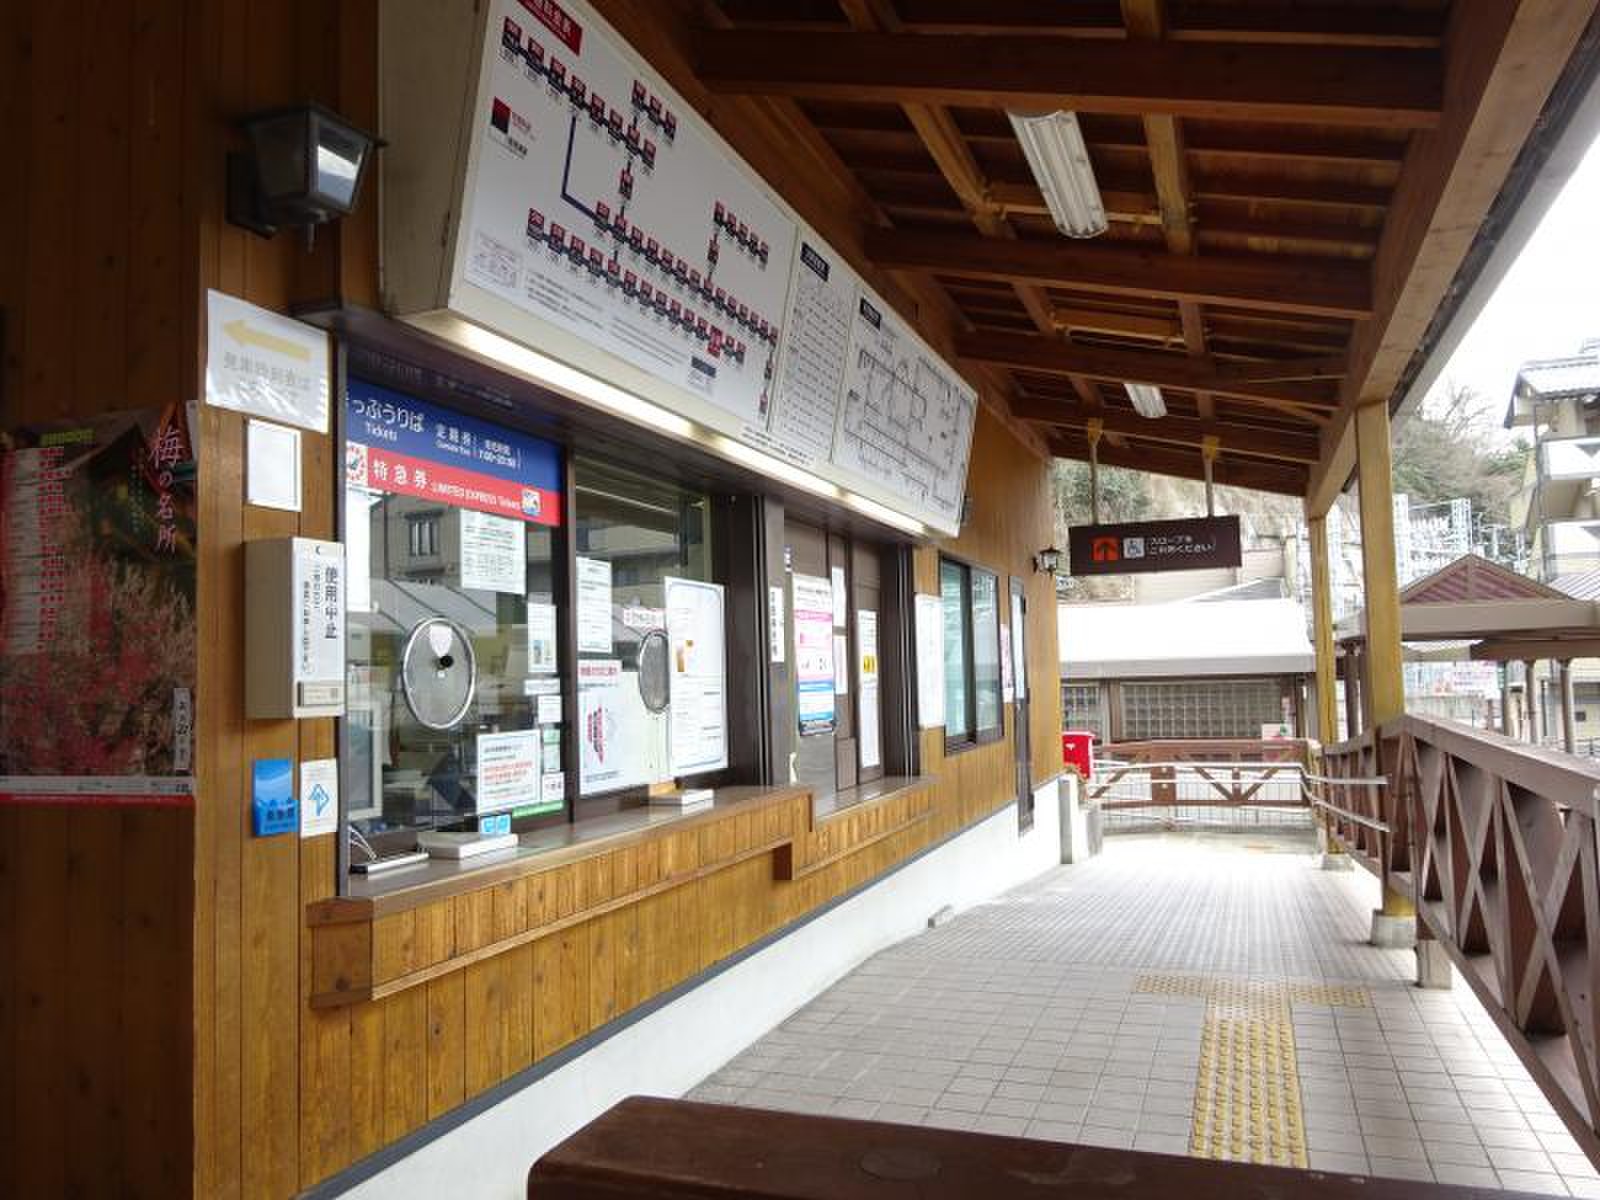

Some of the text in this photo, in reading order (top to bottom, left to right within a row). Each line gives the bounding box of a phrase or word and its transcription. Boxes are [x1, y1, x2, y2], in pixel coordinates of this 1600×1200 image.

[346, 394, 424, 432] っぷうりば
[148, 427, 180, 554] 梅の名所
[372, 459, 430, 490] 特急券
[325, 566, 338, 640] 使用中止
